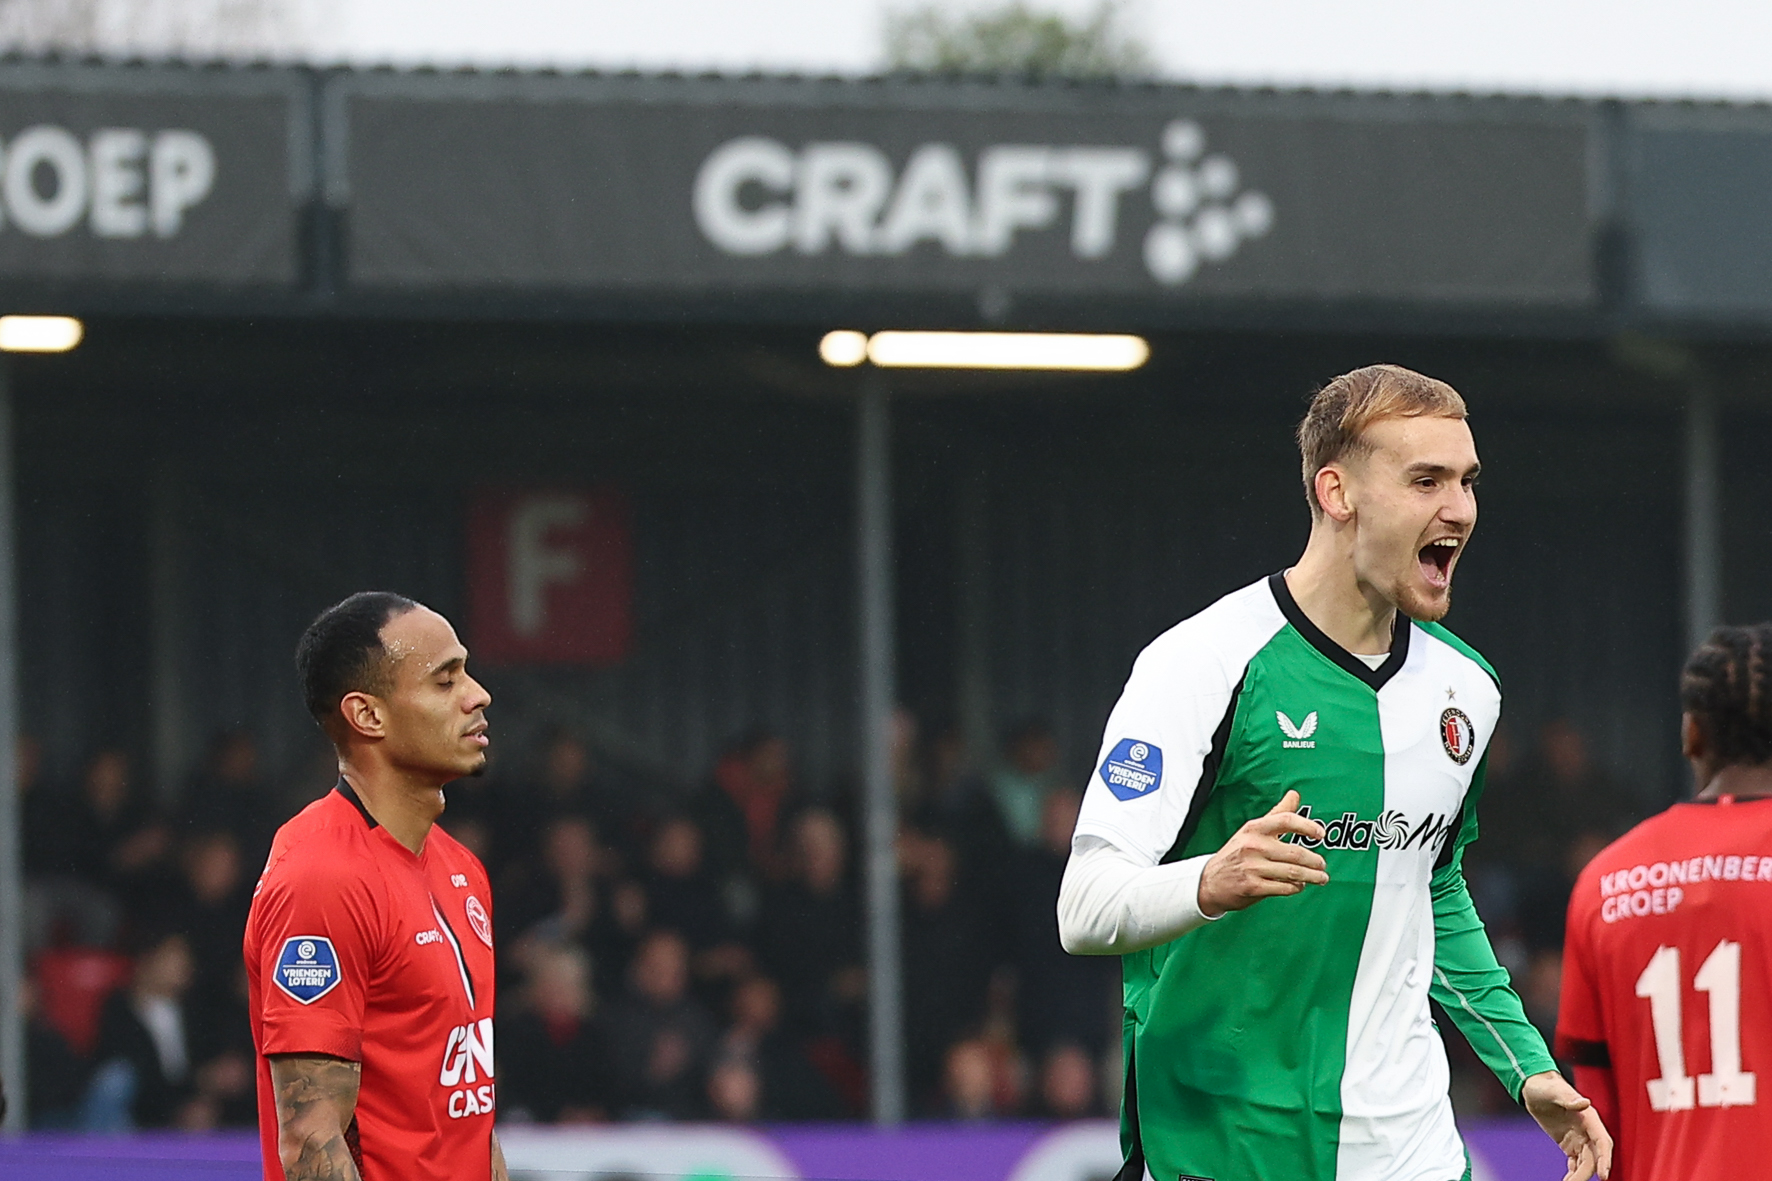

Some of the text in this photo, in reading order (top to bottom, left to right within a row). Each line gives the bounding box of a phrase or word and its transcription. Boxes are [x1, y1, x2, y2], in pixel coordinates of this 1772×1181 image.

[0, 123, 215, 240] OEP
[692, 135, 1149, 257] CRAFT
[509, 495, 588, 636] F
[1108, 764, 1156, 785] VRIENDEN
[1601, 887, 1685, 924] GROEP
[282, 968, 332, 978] VRIENDEN
[288, 977, 326, 987] LOTERIJ
[1635, 938, 1757, 1113] 11
[448, 1083, 496, 1118] CAS
